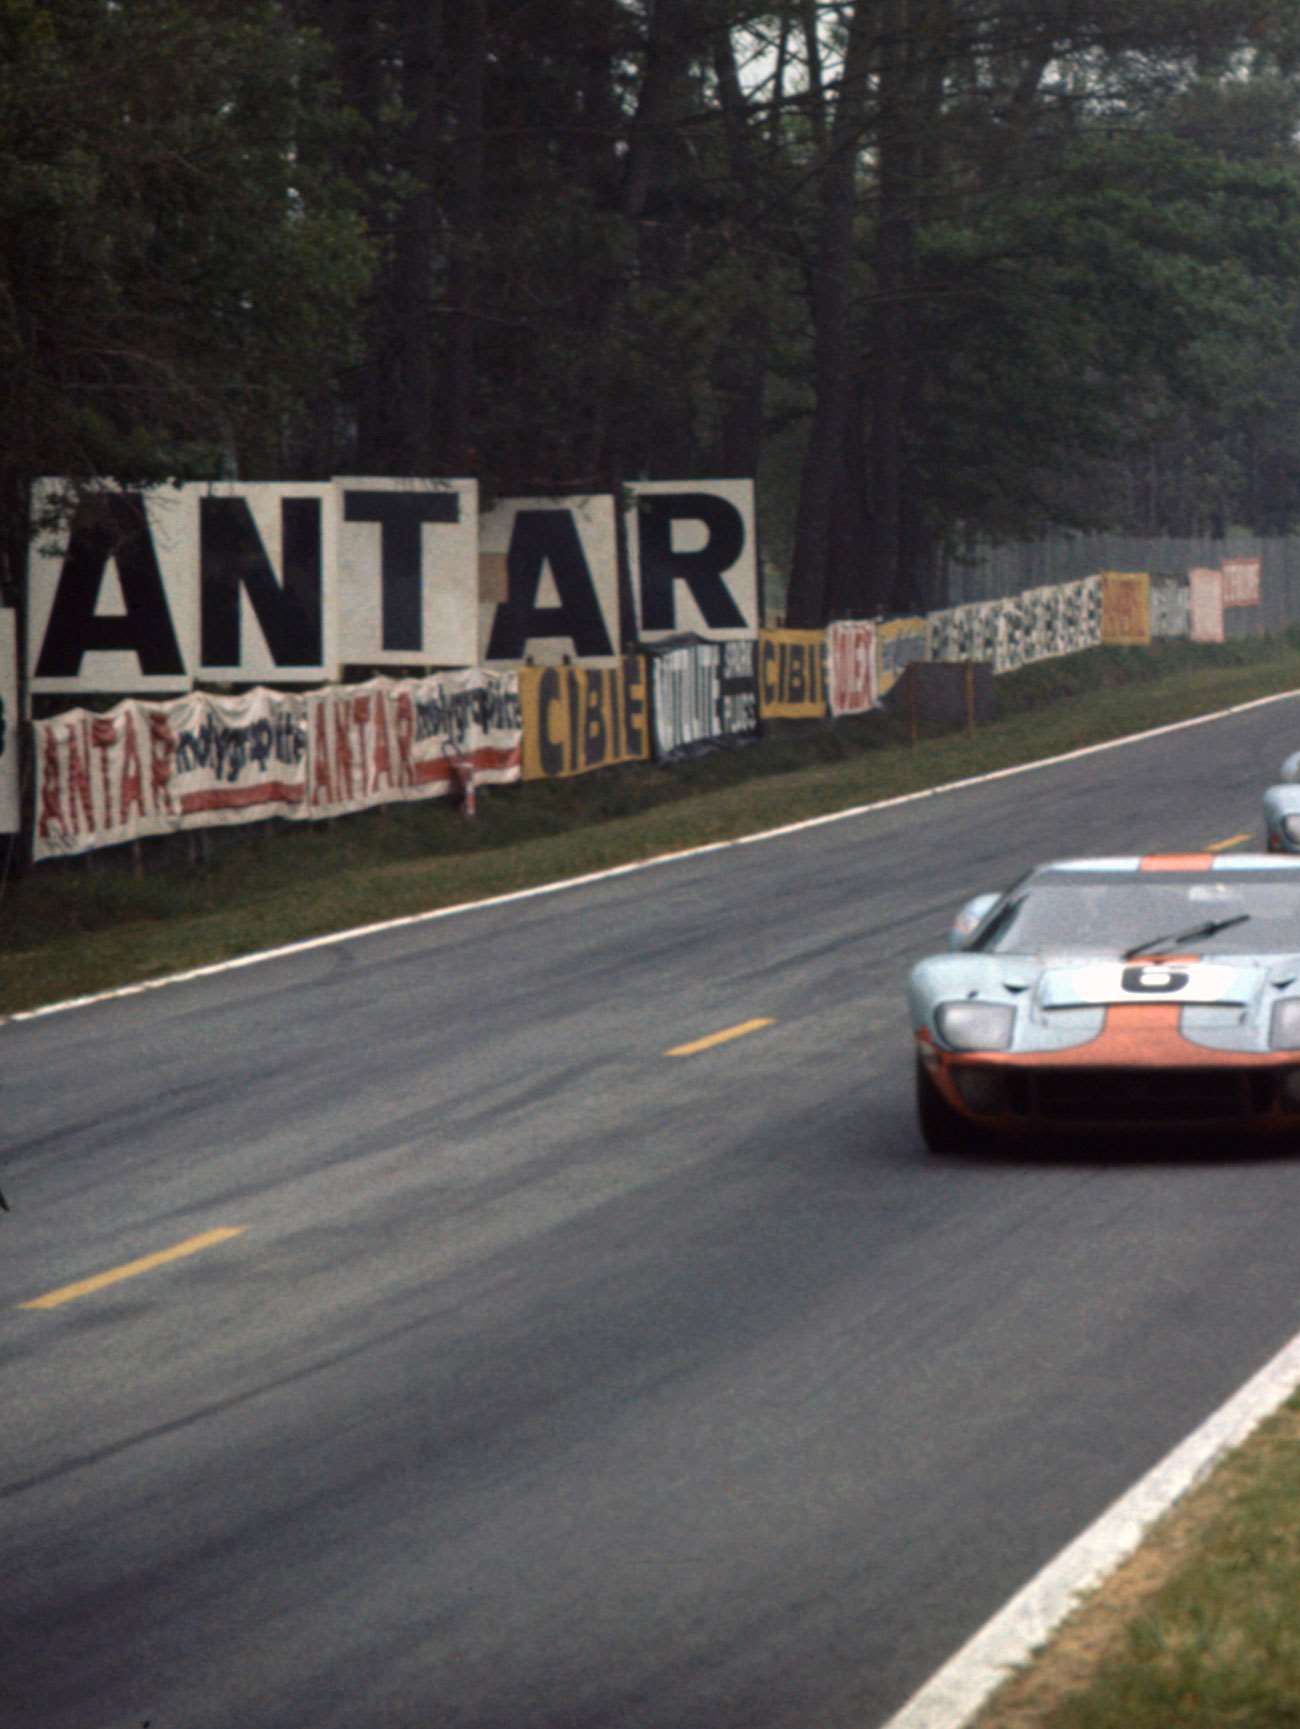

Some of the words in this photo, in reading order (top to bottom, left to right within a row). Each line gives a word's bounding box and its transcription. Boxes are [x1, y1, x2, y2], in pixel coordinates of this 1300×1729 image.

[35, 488, 749, 677] ANTAR
[38, 708, 177, 839] ANTAR
[311, 689, 416, 807] ANTAR
[538, 653, 646, 776] CIBIE
[1121, 964, 1190, 993] 6
